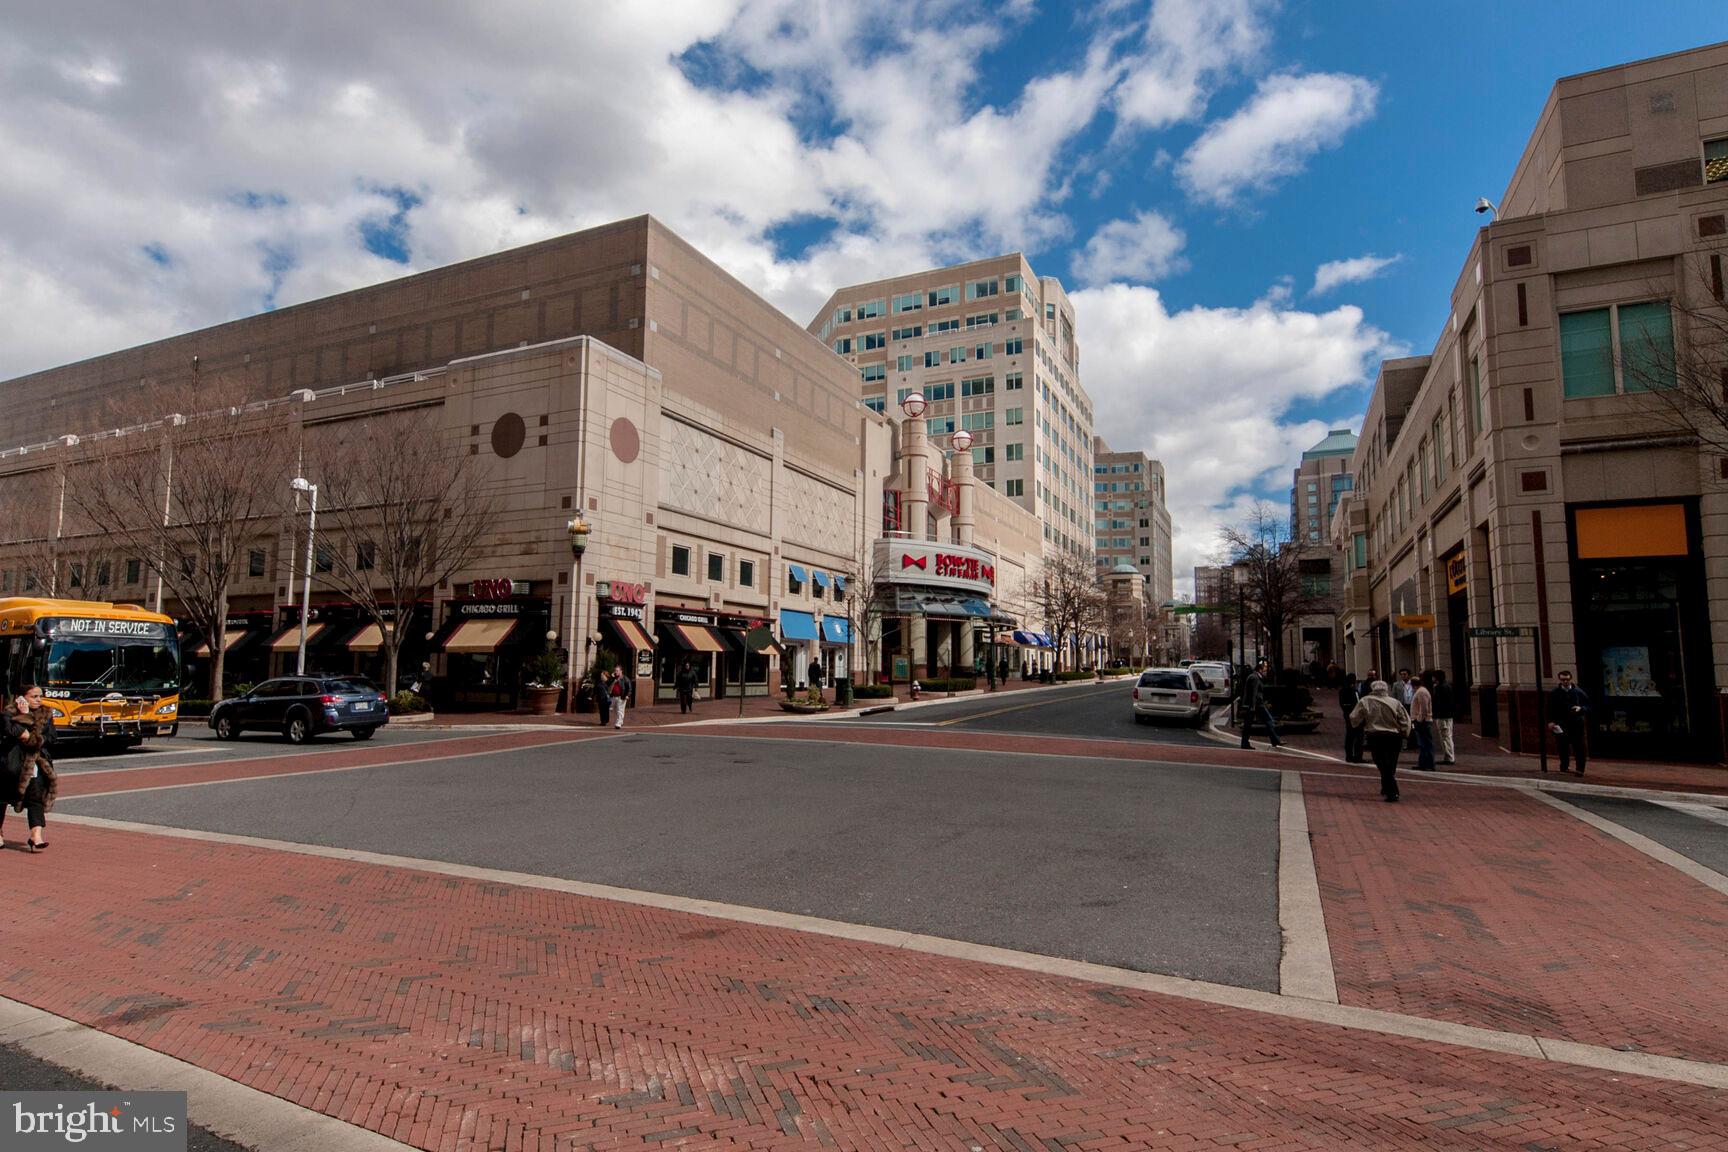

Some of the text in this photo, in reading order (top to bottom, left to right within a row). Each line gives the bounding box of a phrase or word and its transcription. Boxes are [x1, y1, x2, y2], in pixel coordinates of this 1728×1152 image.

[472, 577, 514, 601] UNO
[612, 581, 645, 604] UNO
[461, 604, 519, 614] CHICAGO GRILL
[613, 606, 626, 616] EST.
[70, 619, 150, 634] NOT IN SERVICE
[45, 690, 71, 698] 9649
